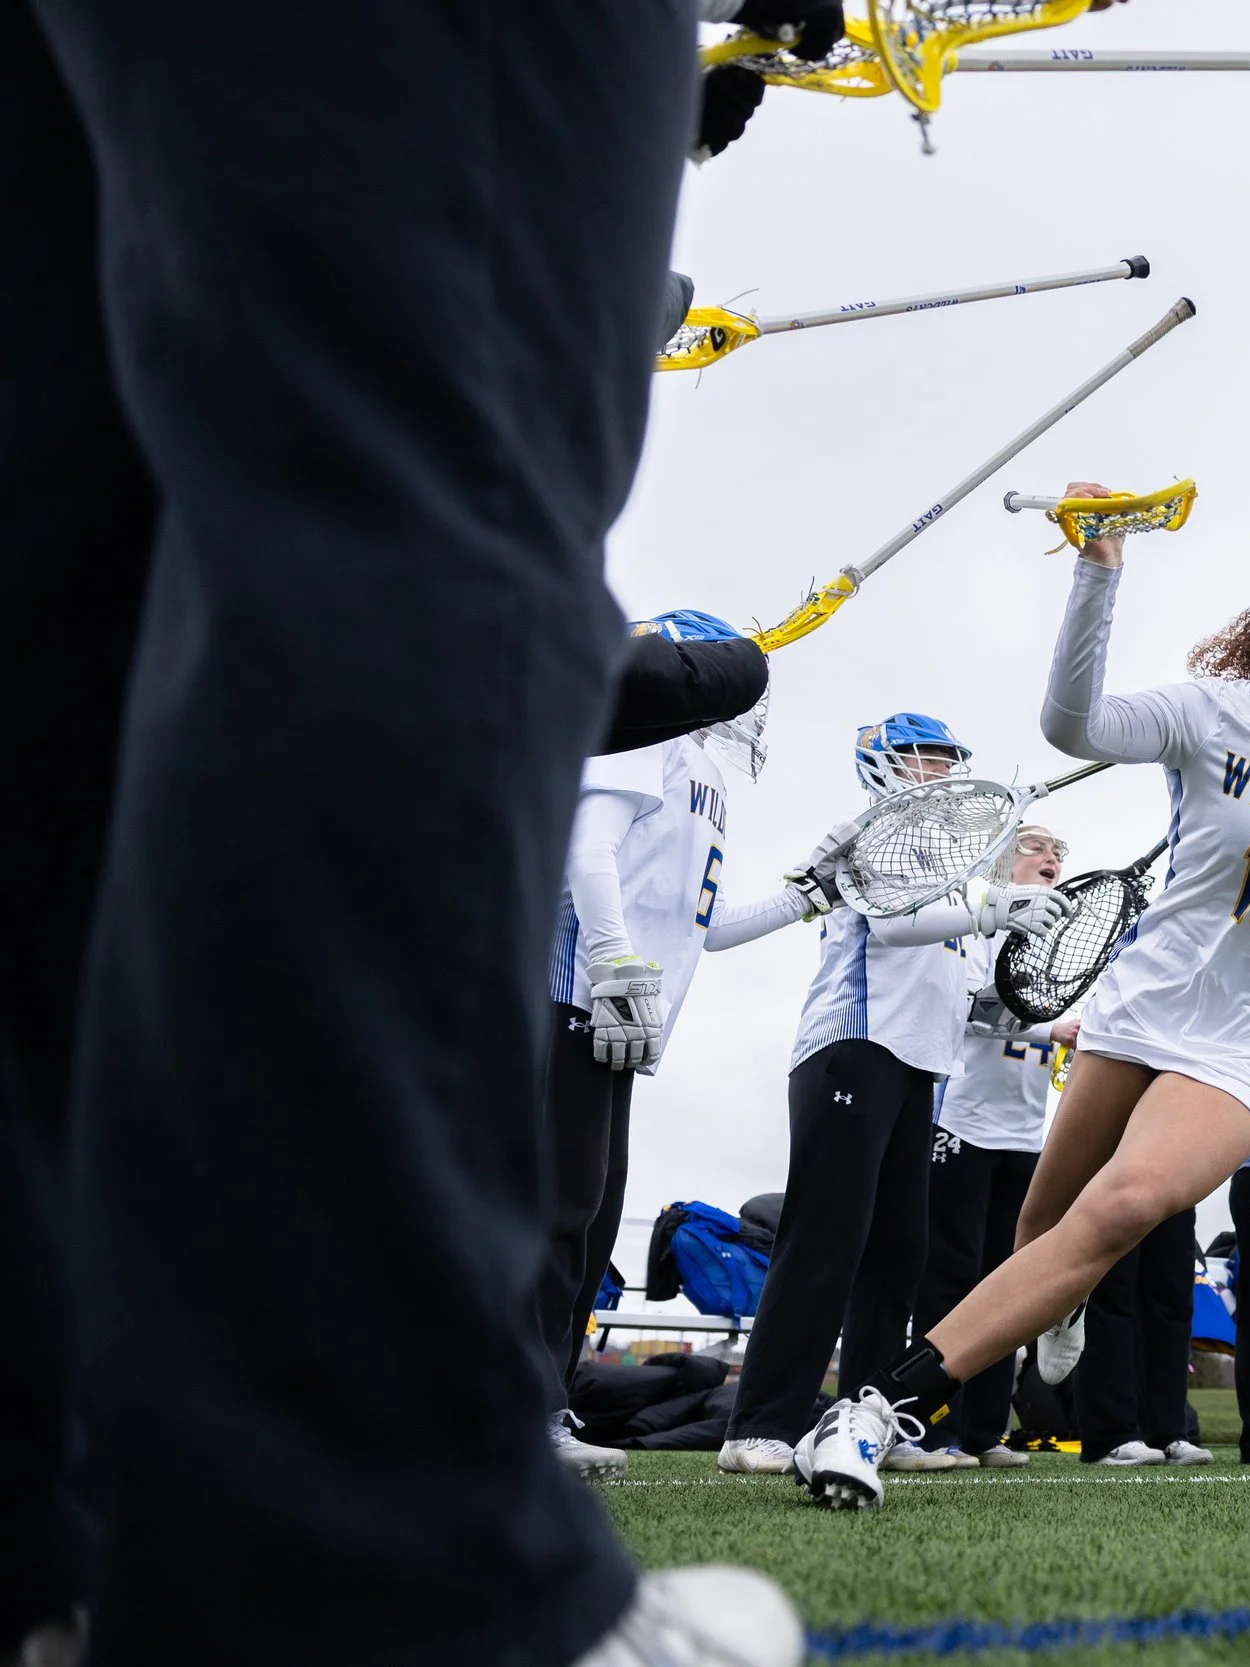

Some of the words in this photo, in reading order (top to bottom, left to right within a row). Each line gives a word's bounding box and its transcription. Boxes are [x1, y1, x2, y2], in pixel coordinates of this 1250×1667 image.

[912, 503, 943, 533] GAIT
[694, 842, 724, 931] 6
[625, 980, 662, 995] STX
[933, 1132, 962, 1154] 24
